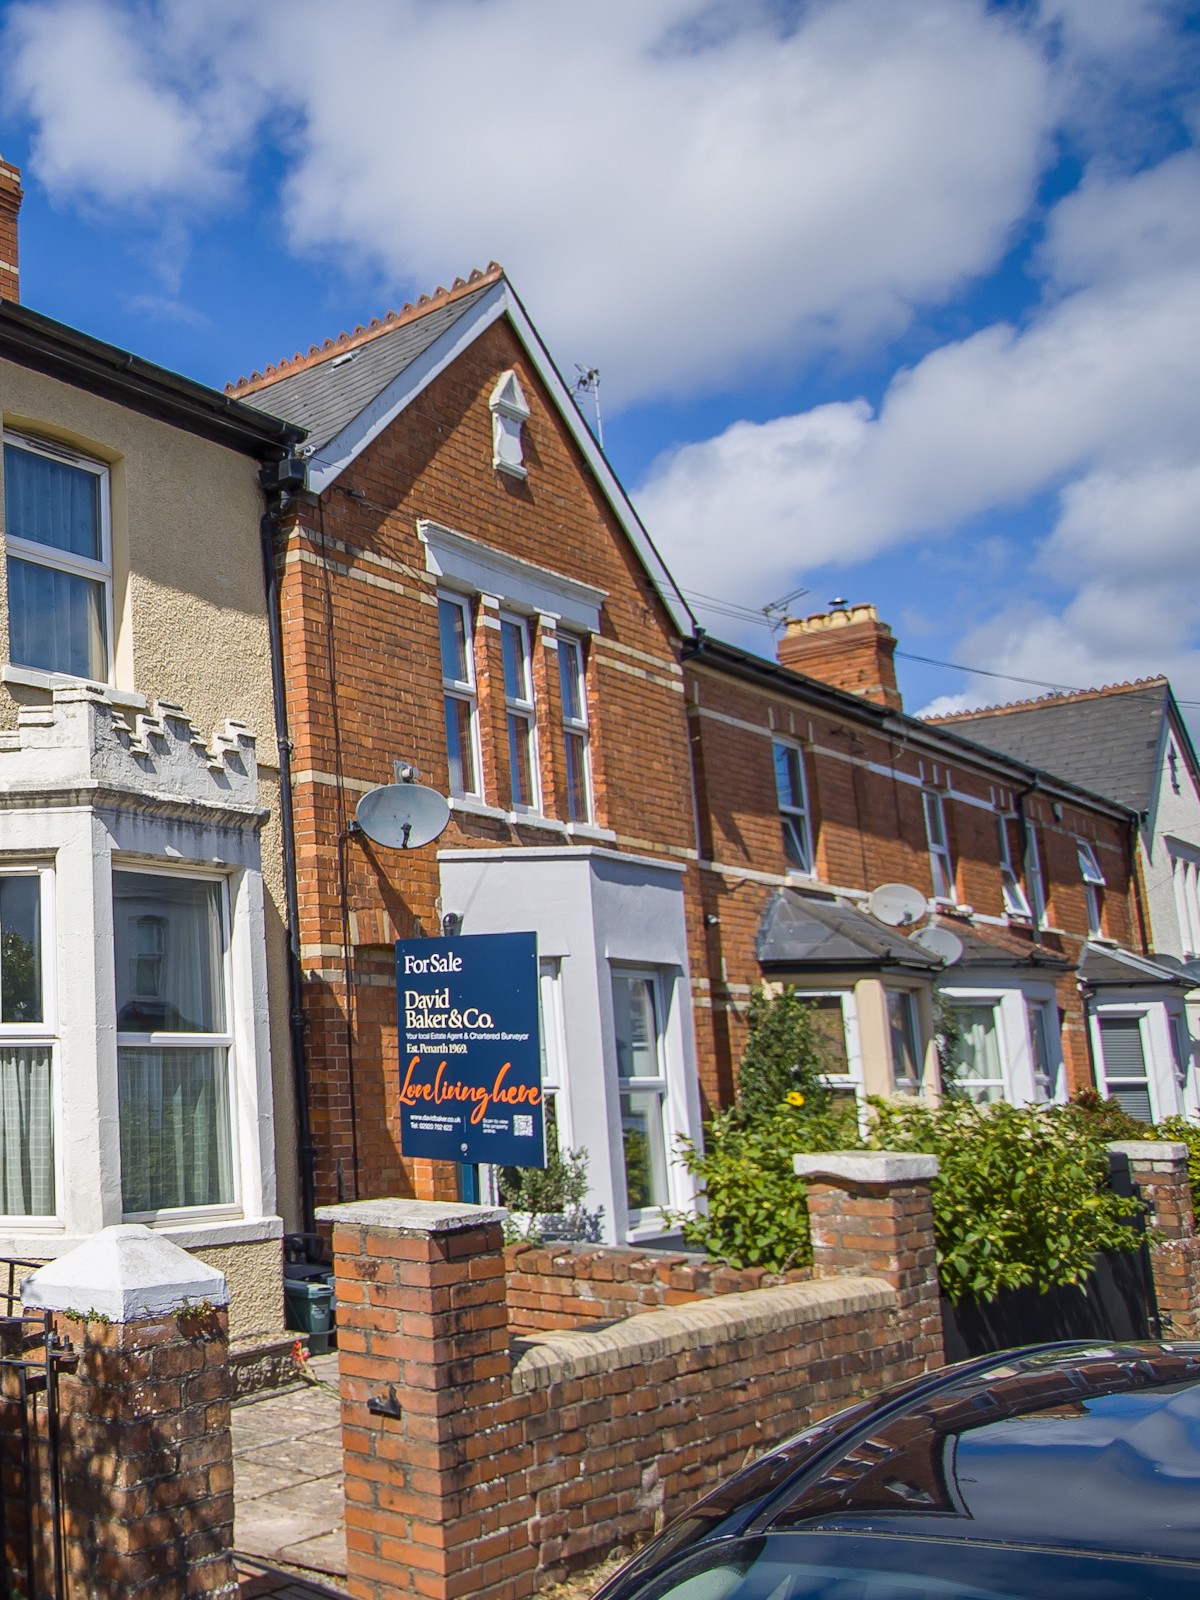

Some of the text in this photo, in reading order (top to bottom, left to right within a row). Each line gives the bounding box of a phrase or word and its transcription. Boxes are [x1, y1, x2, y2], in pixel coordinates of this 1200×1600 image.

[404, 951, 463, 974] For Sale
[404, 988, 451, 1010] David
[406, 1032, 529, 1042] Your local Estate Agent & Chartered Surveyor
[406, 1043, 468, 1054] Est. Penarth 1969.
[399, 1056, 543, 1125] Love living here
